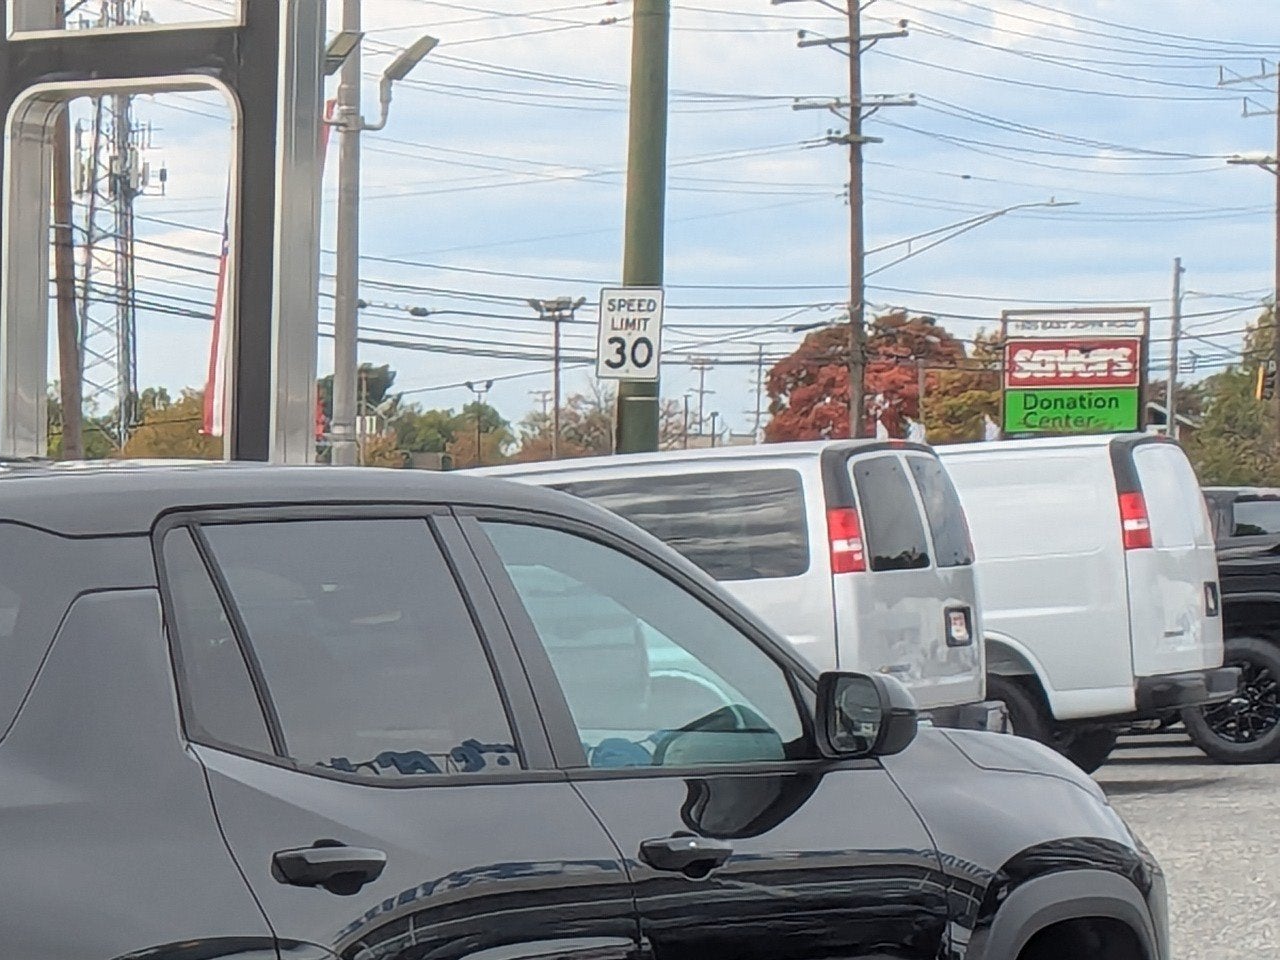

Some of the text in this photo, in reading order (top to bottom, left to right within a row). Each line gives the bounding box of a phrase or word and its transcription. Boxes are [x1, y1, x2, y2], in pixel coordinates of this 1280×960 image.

[607, 298, 657, 312] SPEED
[610, 317, 651, 332] LIMIT
[604, 336, 654, 370] 30
[1022, 392, 1120, 411] Donation
[1022, 411, 1096, 429] Center
